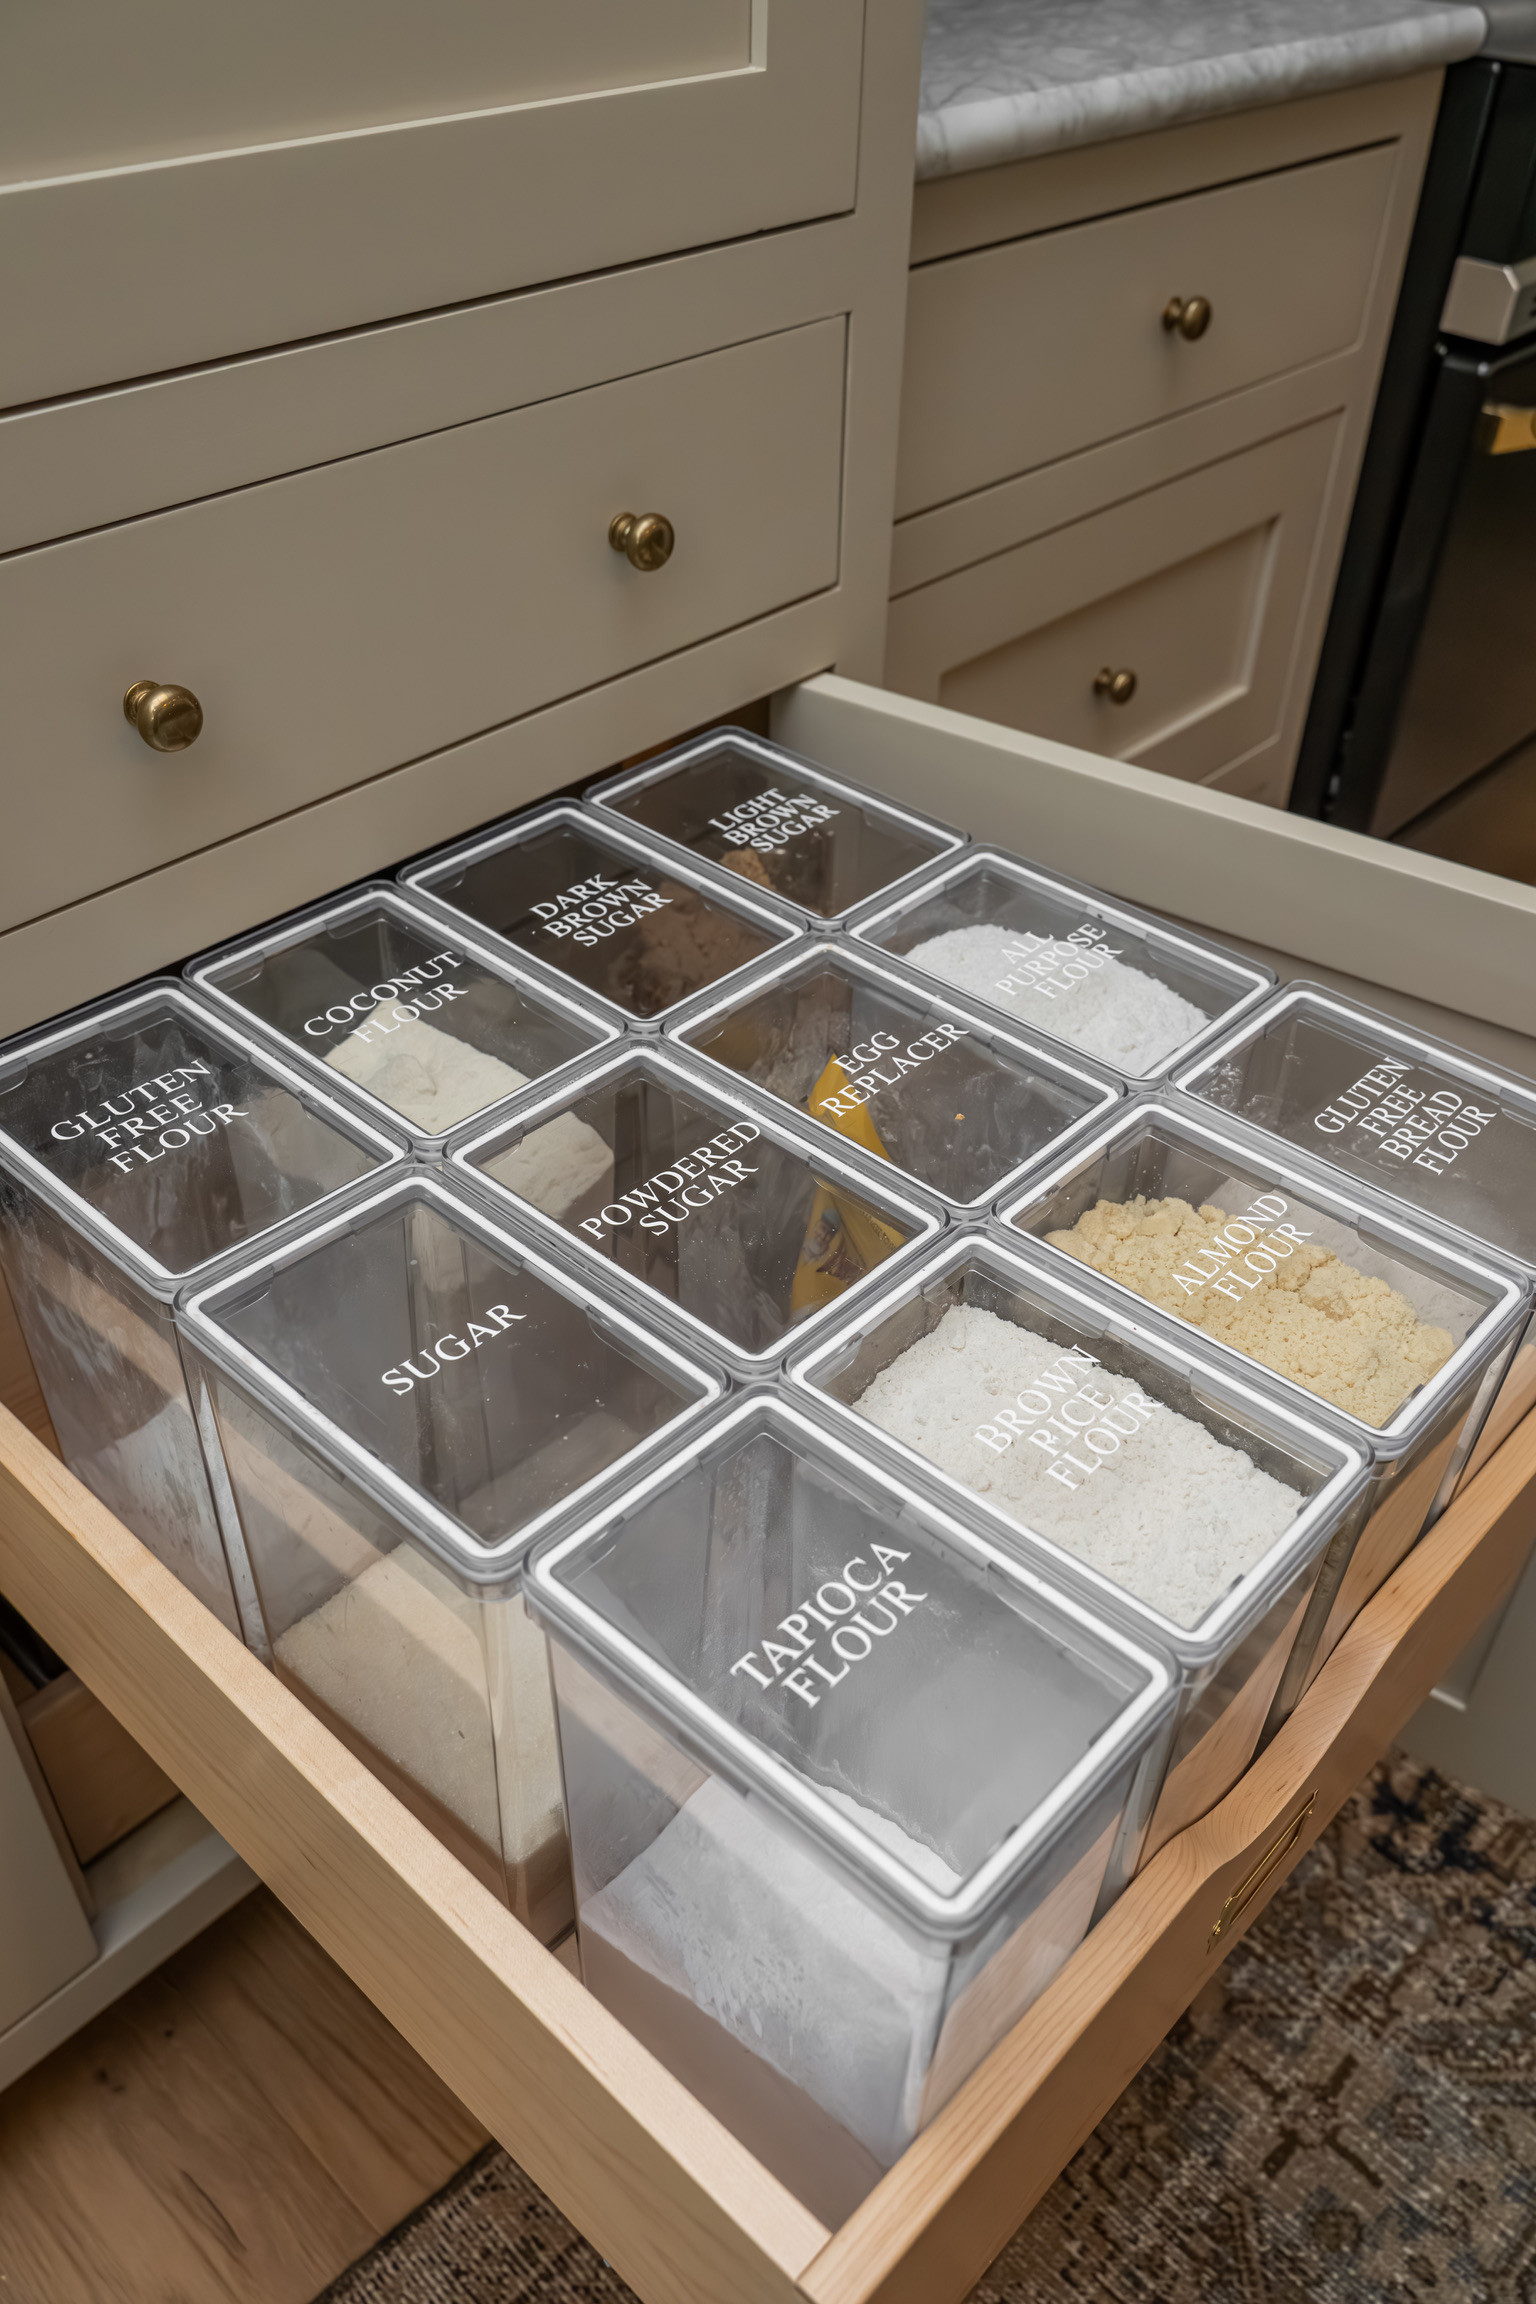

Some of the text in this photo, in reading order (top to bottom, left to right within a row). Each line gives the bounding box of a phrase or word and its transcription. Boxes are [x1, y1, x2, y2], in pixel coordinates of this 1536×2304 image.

[708, 788, 787, 831] LIGHT
[722, 793, 818, 845] BROWN
[750, 804, 841, 852] SUGAR
[529, 873, 619, 921] DARK
[542, 878, 652, 938] BROWN
[573, 892, 674, 947] SUGAR
[994, 923, 1107, 996] PURPOSE
[1001, 931, 1054, 965] ALL
[1033, 943, 1124, 999] FLOUR
[304, 951, 462, 1036] COCONUT
[347, 983, 469, 1044] FLOUR
[818, 1023, 970, 1117] REPLACER
[832, 1031, 900, 1075] EGG
[50, 1059, 211, 1140] GLUTEN
[95, 1093, 202, 1149] FREE
[1314, 1056, 1411, 1134] GLUTEN
[1356, 1084, 1426, 1138] FREE
[1378, 1090, 1463, 1160] BREAD
[107, 1103, 249, 1174] FLOUR
[1412, 1105, 1497, 1176] FLOUR
[578, 1121, 761, 1241] POWDERED
[639, 1159, 759, 1236] SUGAR
[1171, 1194, 1288, 1296] ALMOND
[1211, 1223, 1314, 1302] FLOUR
[381, 1304, 527, 1396] SUGAR
[974, 1343, 1101, 1453] BROWN
[1044, 1392, 1165, 1491] FLOUR
[729, 1543, 912, 1690] TAPIOCA
[781, 1580, 928, 1709] FLOUR
